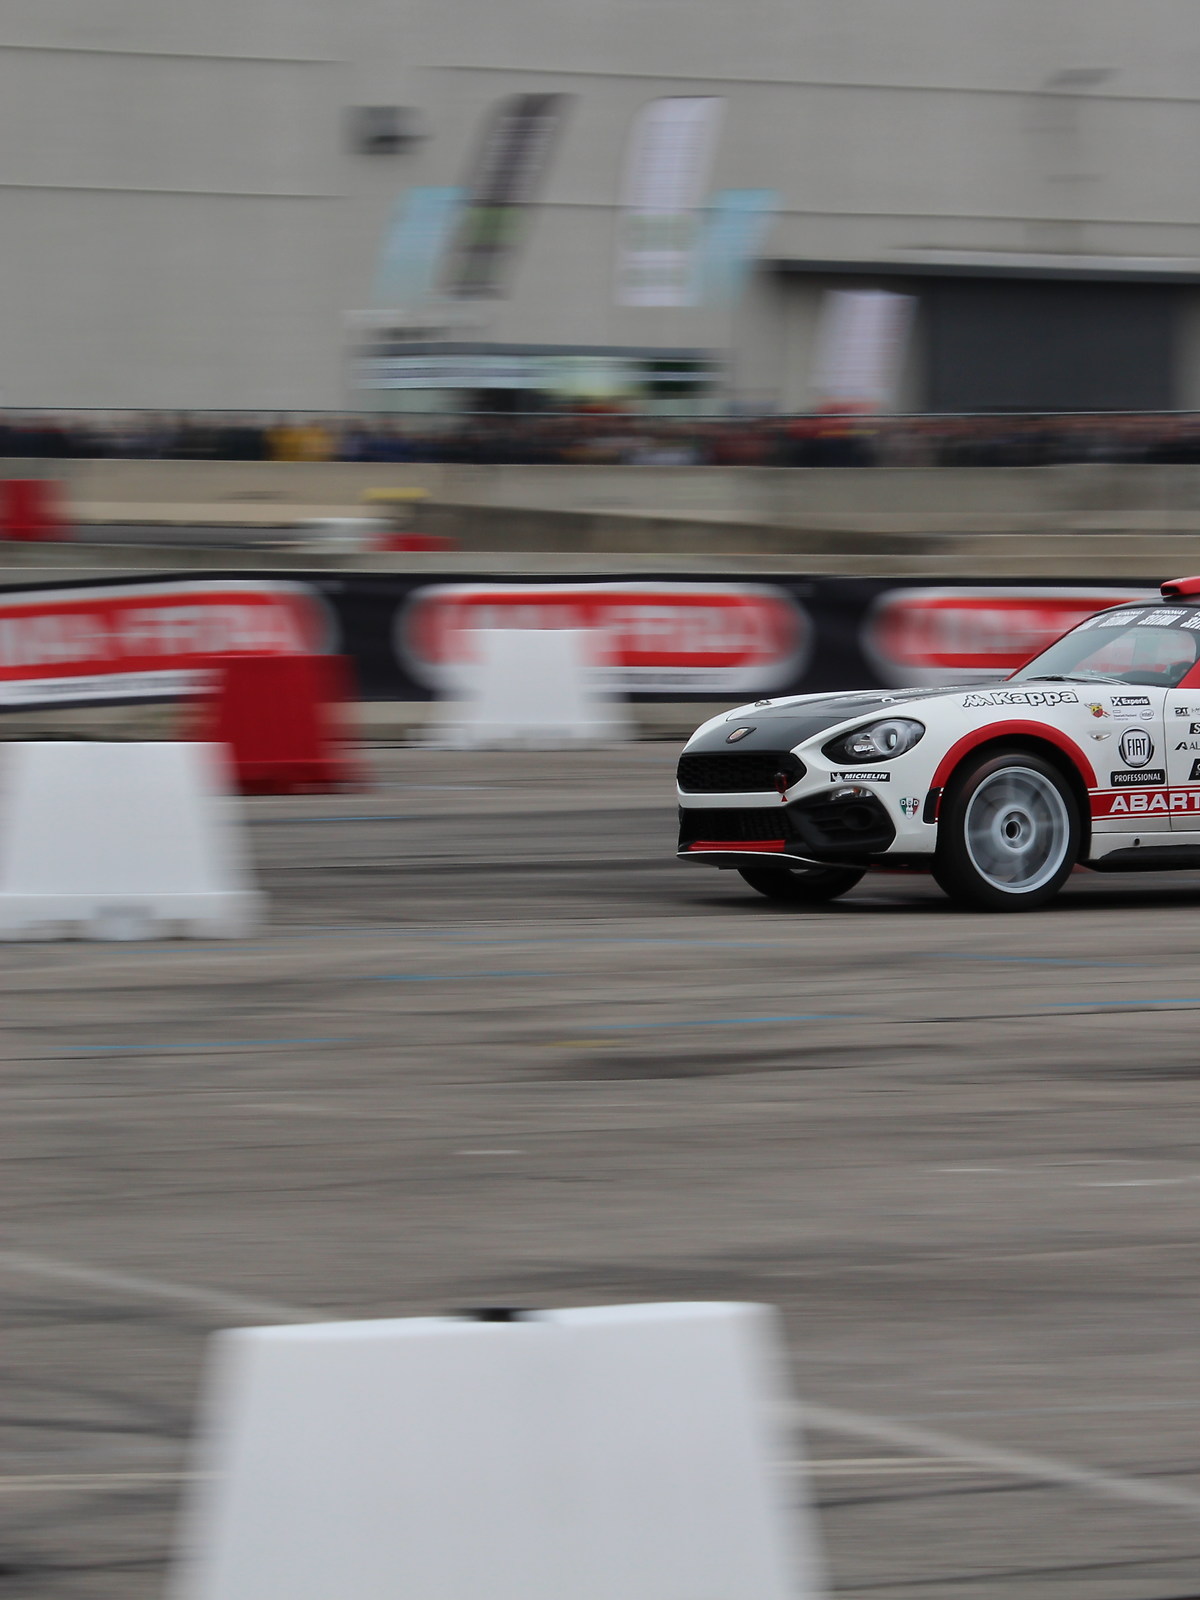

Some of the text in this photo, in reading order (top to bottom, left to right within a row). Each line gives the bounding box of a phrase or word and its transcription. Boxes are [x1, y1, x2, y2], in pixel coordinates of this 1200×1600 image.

[990, 691, 1079, 706] Kappa
[1121, 697, 1149, 705] Experis
[1127, 738, 1146, 756] FIAT
[1114, 773, 1162, 782] PROFESSIONAL
